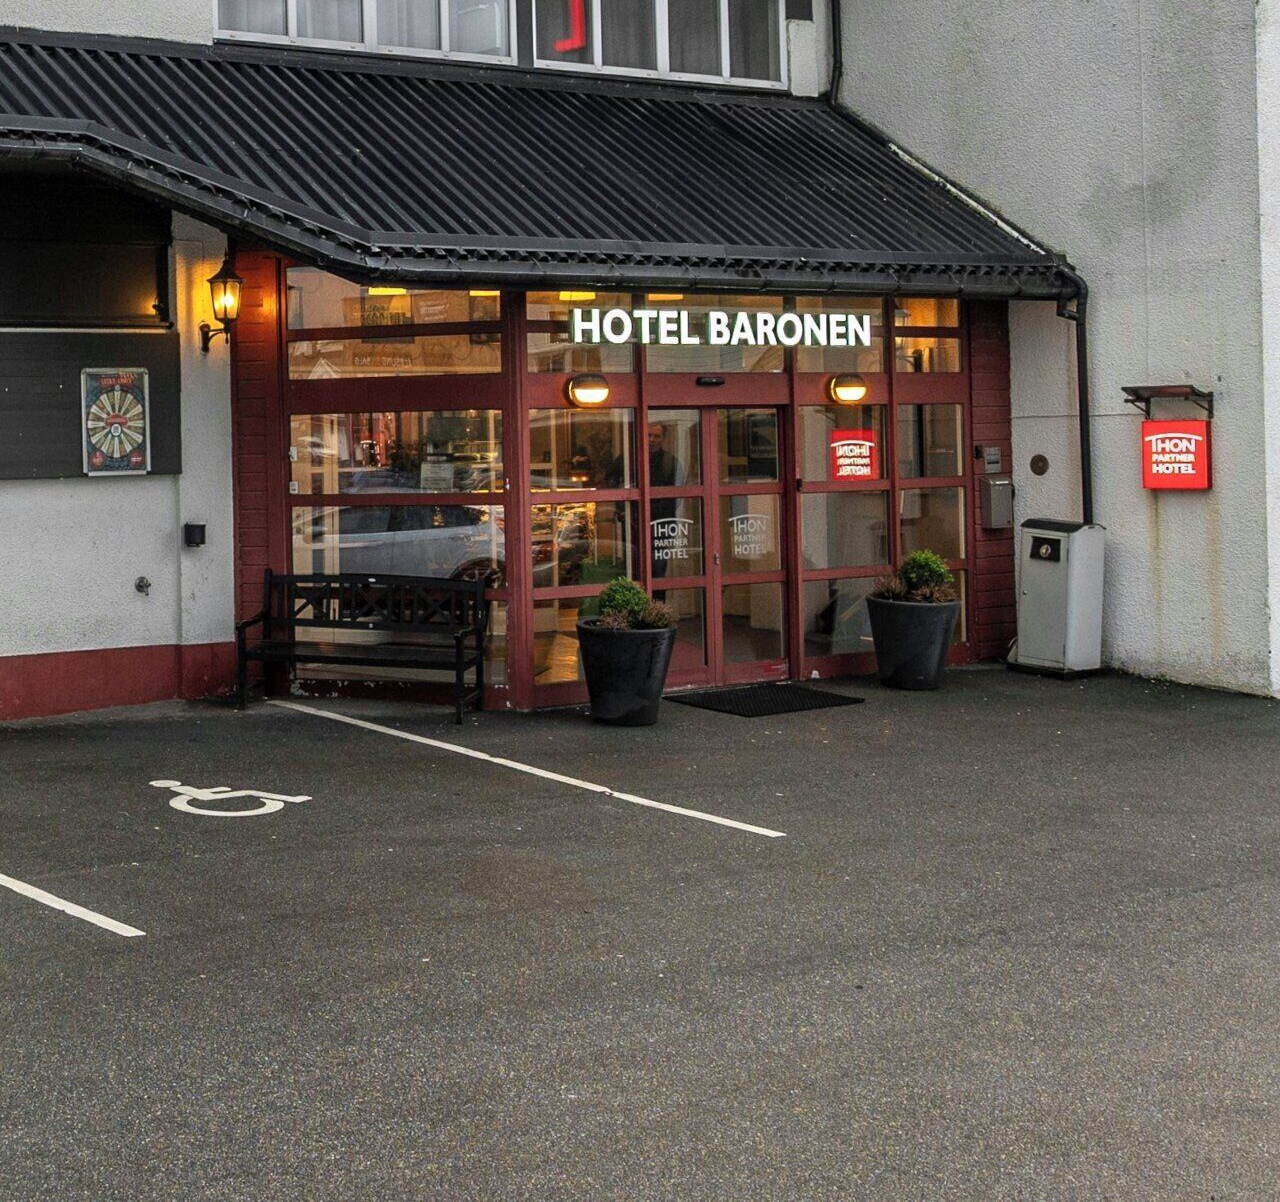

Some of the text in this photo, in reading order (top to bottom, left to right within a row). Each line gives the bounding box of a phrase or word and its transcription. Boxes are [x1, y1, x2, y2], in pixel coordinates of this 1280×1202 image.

[573, 308, 871, 346] HOTEL BARONEN
[1145, 433, 1202, 453] THON
[1152, 454, 1195, 462] PARTNER
[1152, 463, 1196, 474] HOTEL
[650, 517, 693, 537] THON
[729, 514, 768, 533] THON
[654, 538, 688, 547] PARTNER
[654, 548, 688, 560] HOTEL
[734, 543, 767, 555] HOTEL
